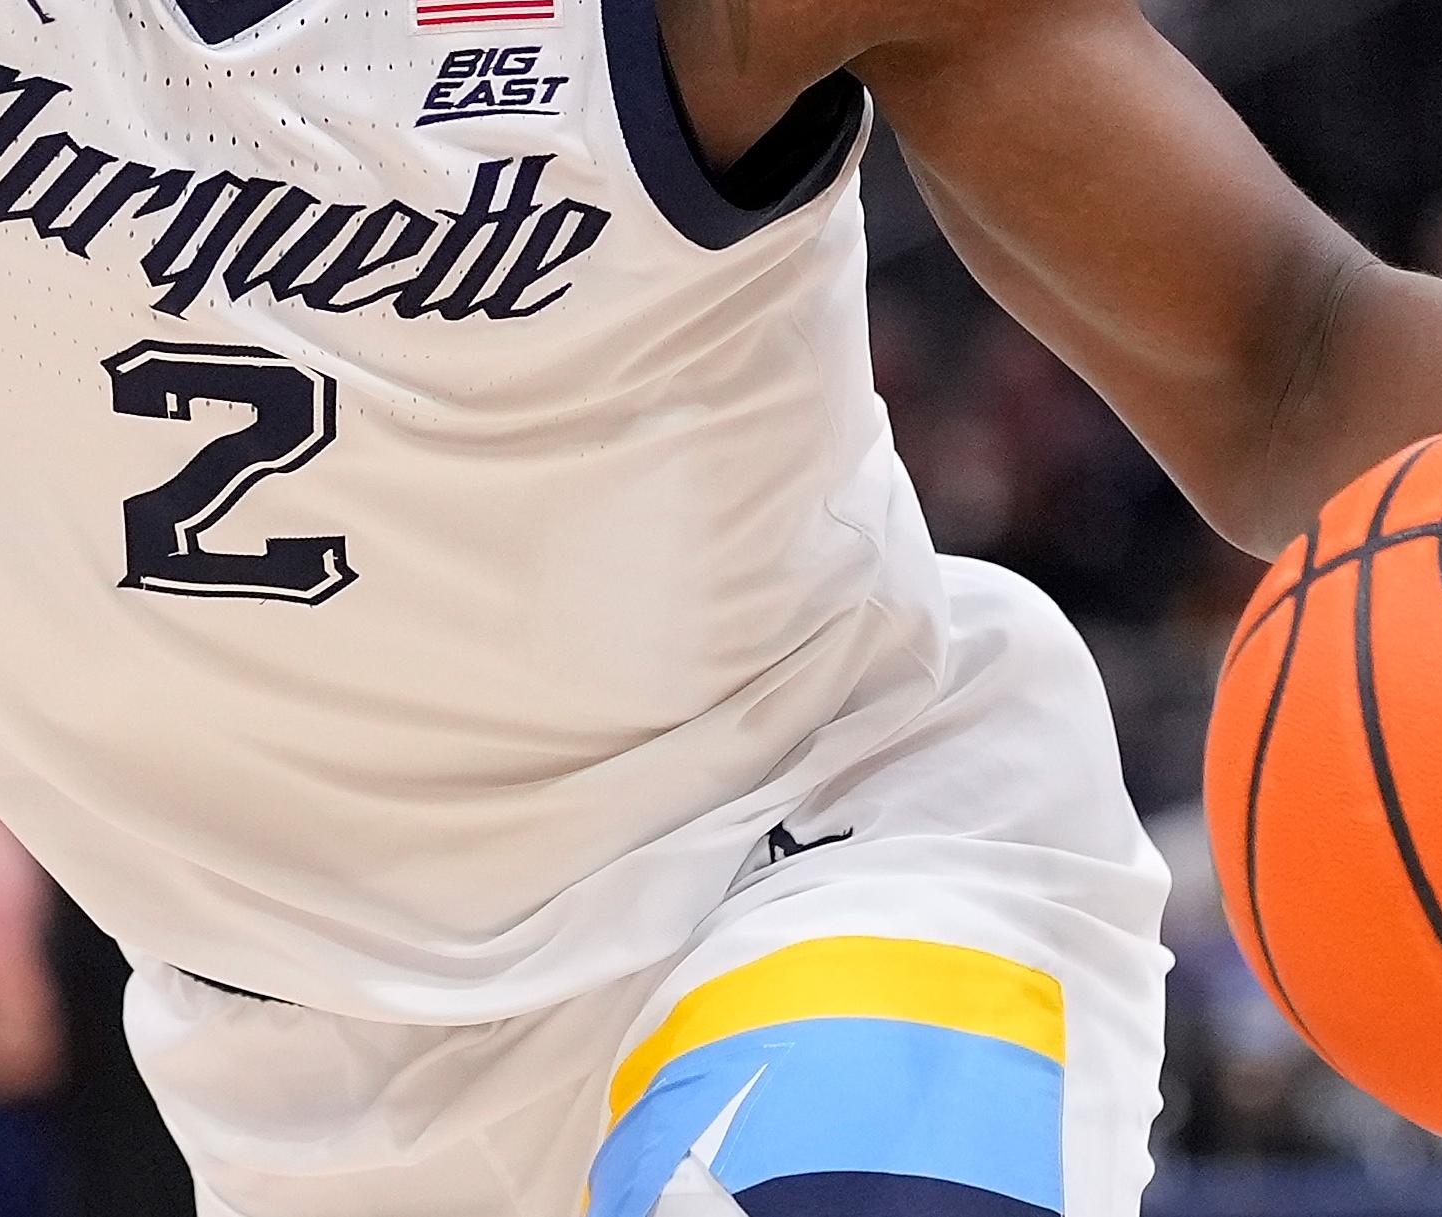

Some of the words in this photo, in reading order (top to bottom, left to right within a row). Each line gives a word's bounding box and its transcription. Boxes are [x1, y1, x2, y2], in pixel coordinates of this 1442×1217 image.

[436, 45, 543, 80] BIG
[422, 76, 570, 110] EAST
[99, 339, 360, 607] 2
